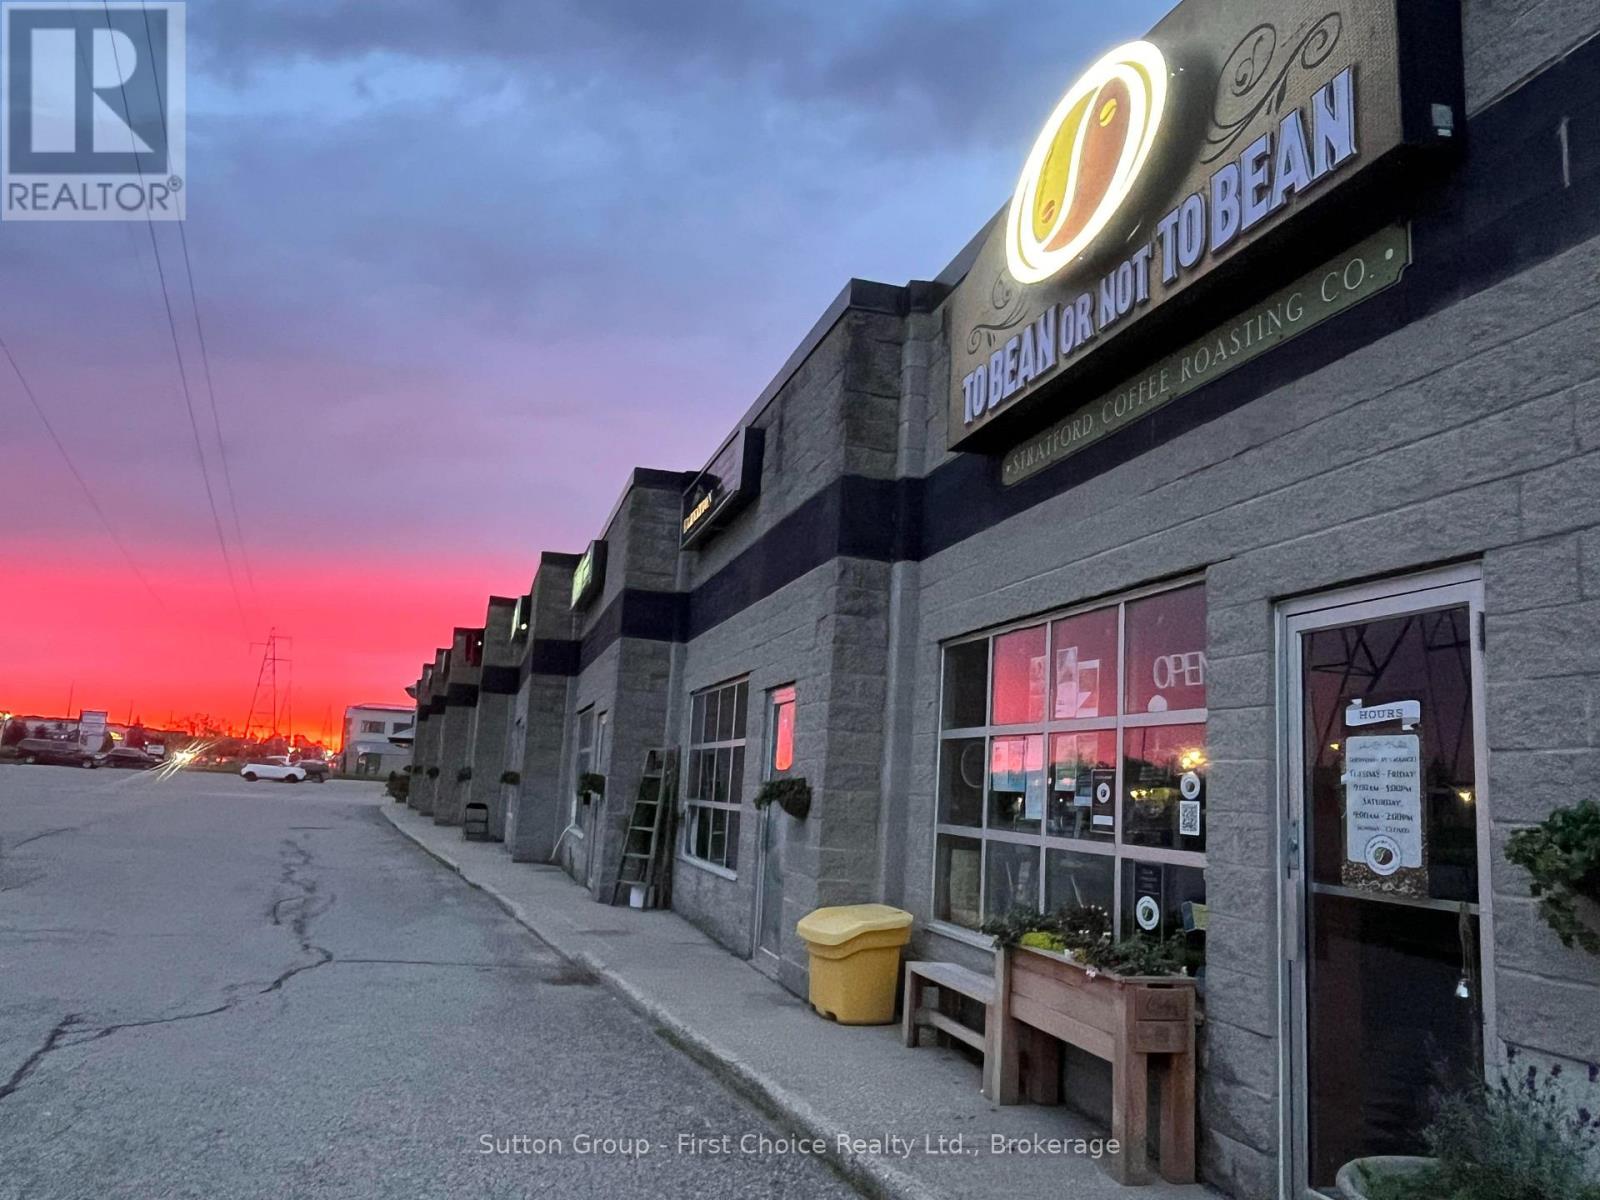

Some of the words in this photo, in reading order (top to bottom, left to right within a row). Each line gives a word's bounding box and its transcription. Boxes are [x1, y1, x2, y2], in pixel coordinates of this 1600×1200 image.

[962, 363, 988, 424] TO
[988, 304, 1058, 410] BEAN
[1060, 292, 1096, 355] OR
[1099, 243, 1153, 331] NOT
[1156, 191, 1205, 287] TO
[1210, 66, 1358, 252] BEAN
[1012, 413, 1094, 475] STRATFORD
[1101, 367, 1170, 425] COFFEE
[1179, 292, 1304, 384] ROASTING
[1321, 257, 1376, 303] CO.
[1359, 708, 1405, 720] HOURS
